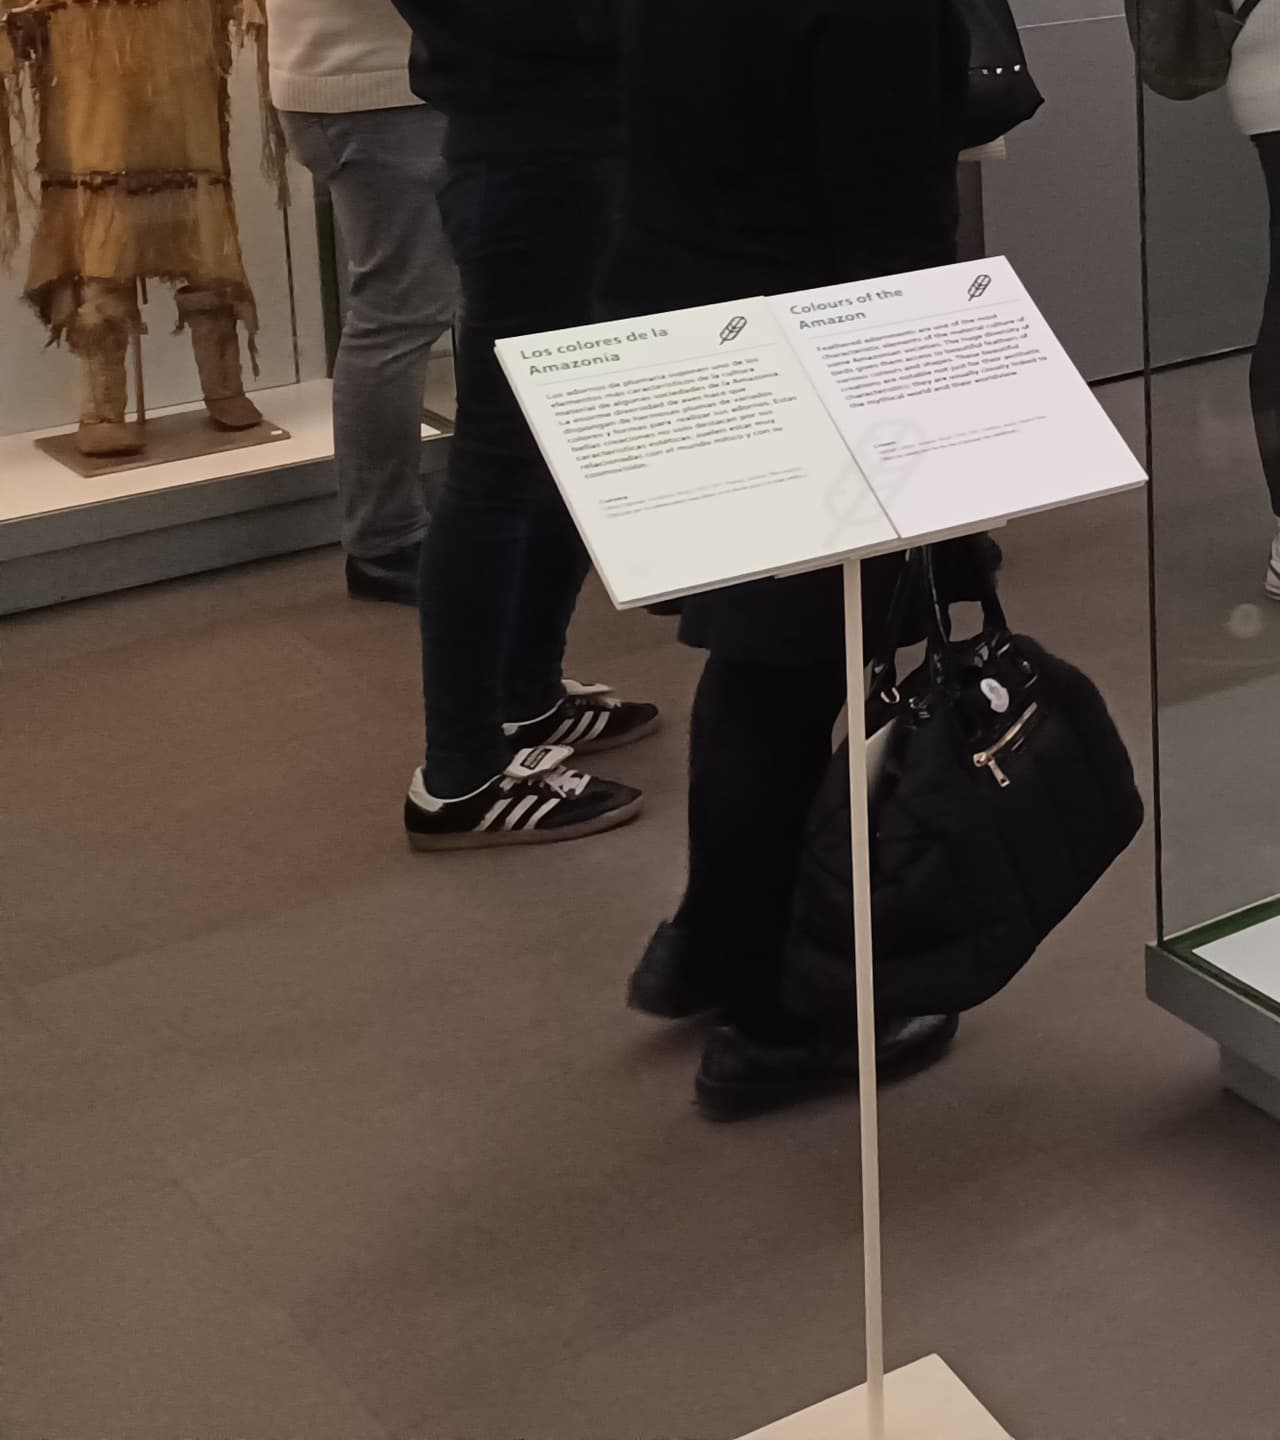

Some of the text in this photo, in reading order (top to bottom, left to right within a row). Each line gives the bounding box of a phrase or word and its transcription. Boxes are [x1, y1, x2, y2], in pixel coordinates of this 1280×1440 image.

[789, 288, 904, 315] Colours of the
[798, 310, 867, 330] Amazon
[519, 327, 670, 361] Los colores de la
